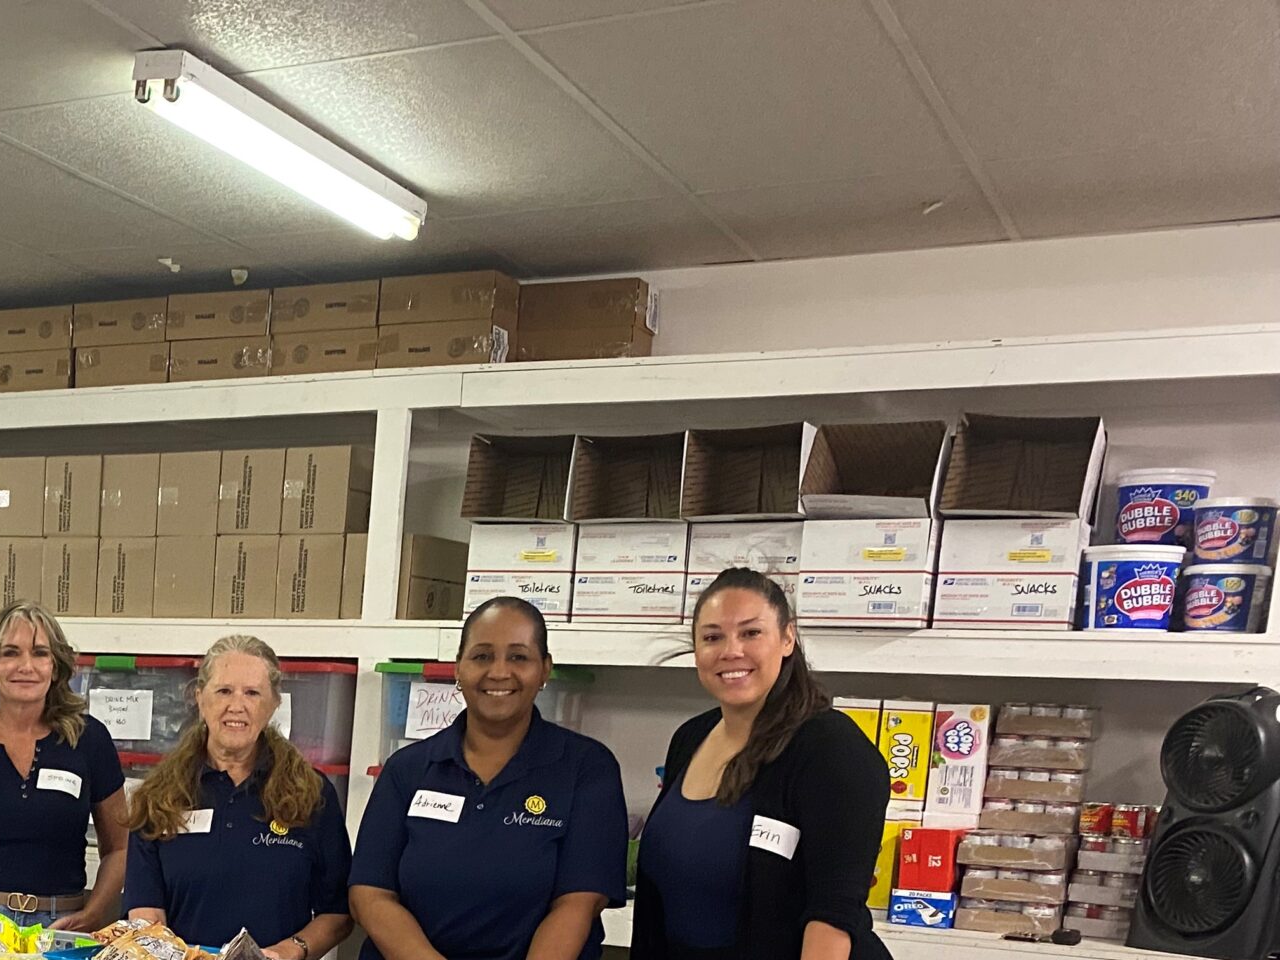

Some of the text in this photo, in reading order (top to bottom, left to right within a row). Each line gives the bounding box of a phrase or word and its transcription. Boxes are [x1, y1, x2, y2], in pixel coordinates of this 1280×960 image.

[1174, 489, 1196, 500] 340
[1121, 505, 1172, 523] DUBBLE
[1122, 516, 1173, 533] BUBBLE
[518, 582, 561, 594] Toiletries
[628, 583, 675, 594] Toiletries
[858, 583, 902, 597] SNACKS
[1011, 582, 1057, 596] SNACKS
[1121, 583, 1171, 599] DUBBLE
[1123, 594, 1172, 610] BUBBLE
[945, 729, 959, 752] POP
[955, 721, 974, 755] BLOW
[890, 733, 913, 778] POPS
[503, 812, 563, 828] Meridiana
[252, 833, 303, 849] Meridiana
[752, 825, 781, 845] Erin
[894, 903, 924, 911] OREO
